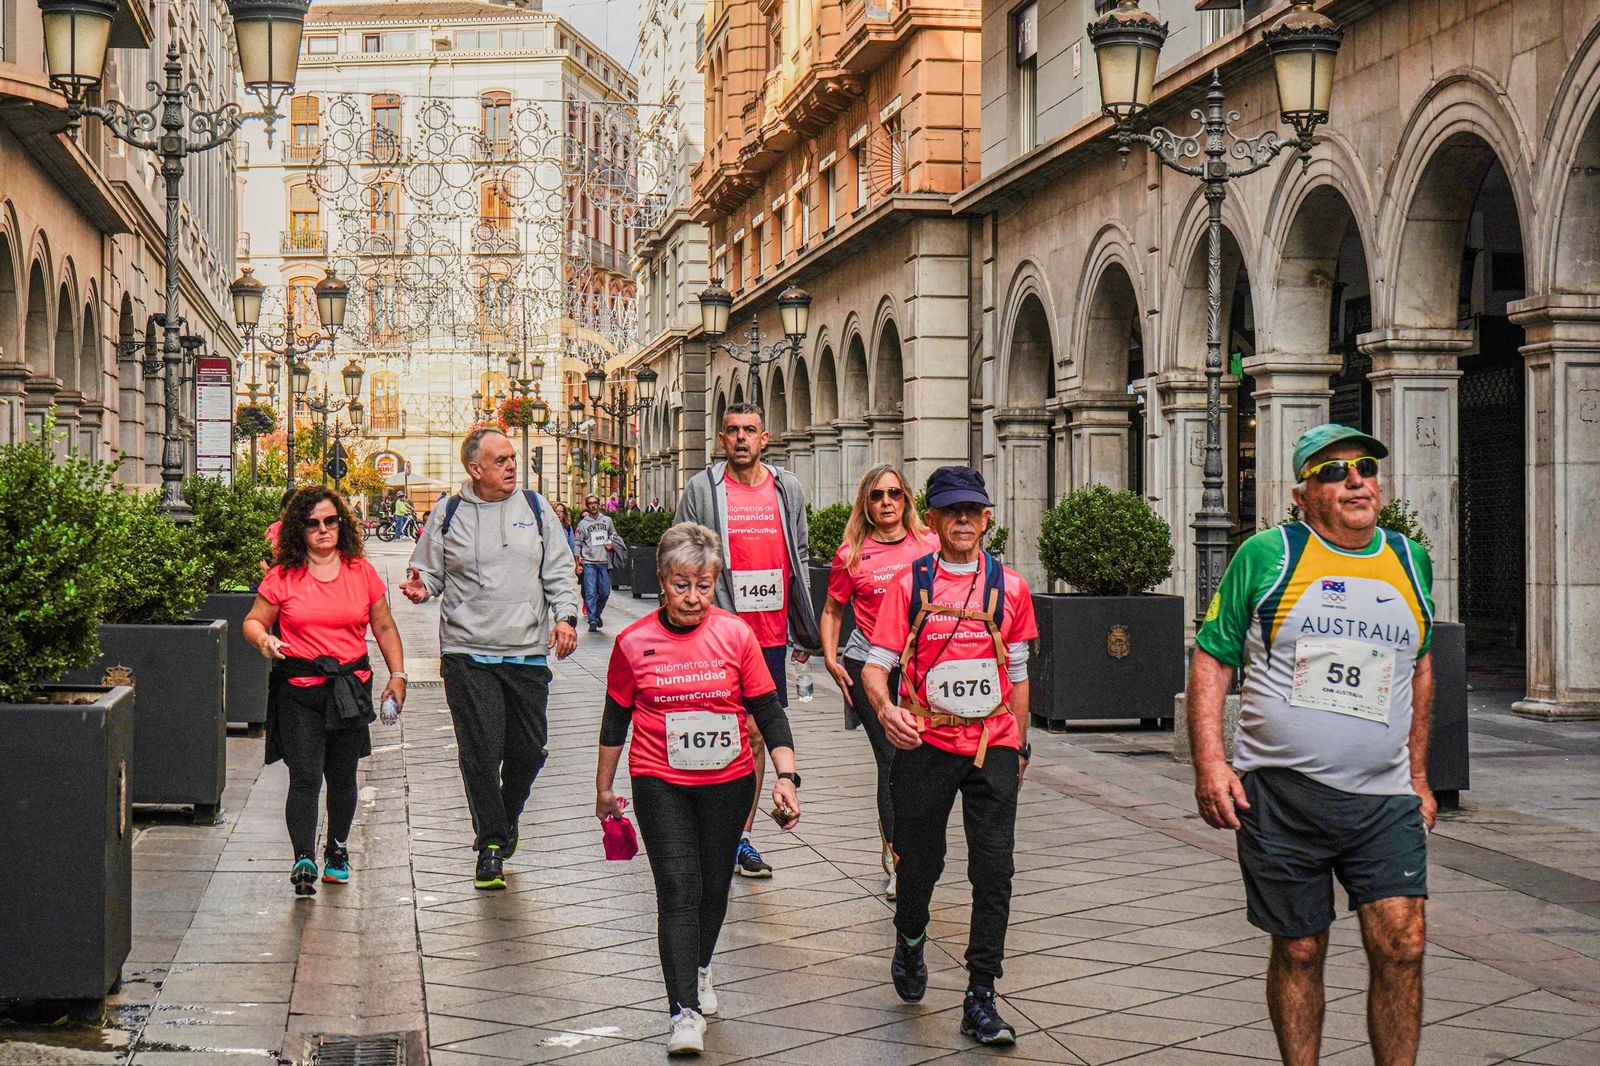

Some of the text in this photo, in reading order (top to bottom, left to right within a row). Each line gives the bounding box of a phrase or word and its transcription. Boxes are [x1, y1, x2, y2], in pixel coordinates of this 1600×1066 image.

[740, 583, 777, 597] 1464
[1300, 616, 1411, 646] AUSTRALIA
[655, 659, 725, 674] kilómetros de
[1326, 662, 1361, 688] 58
[656, 669, 727, 686] humanidad
[653, 689, 731, 703] #CarreraCruzRoja
[938, 678, 992, 698] 1676
[679, 731, 732, 749] 1675
